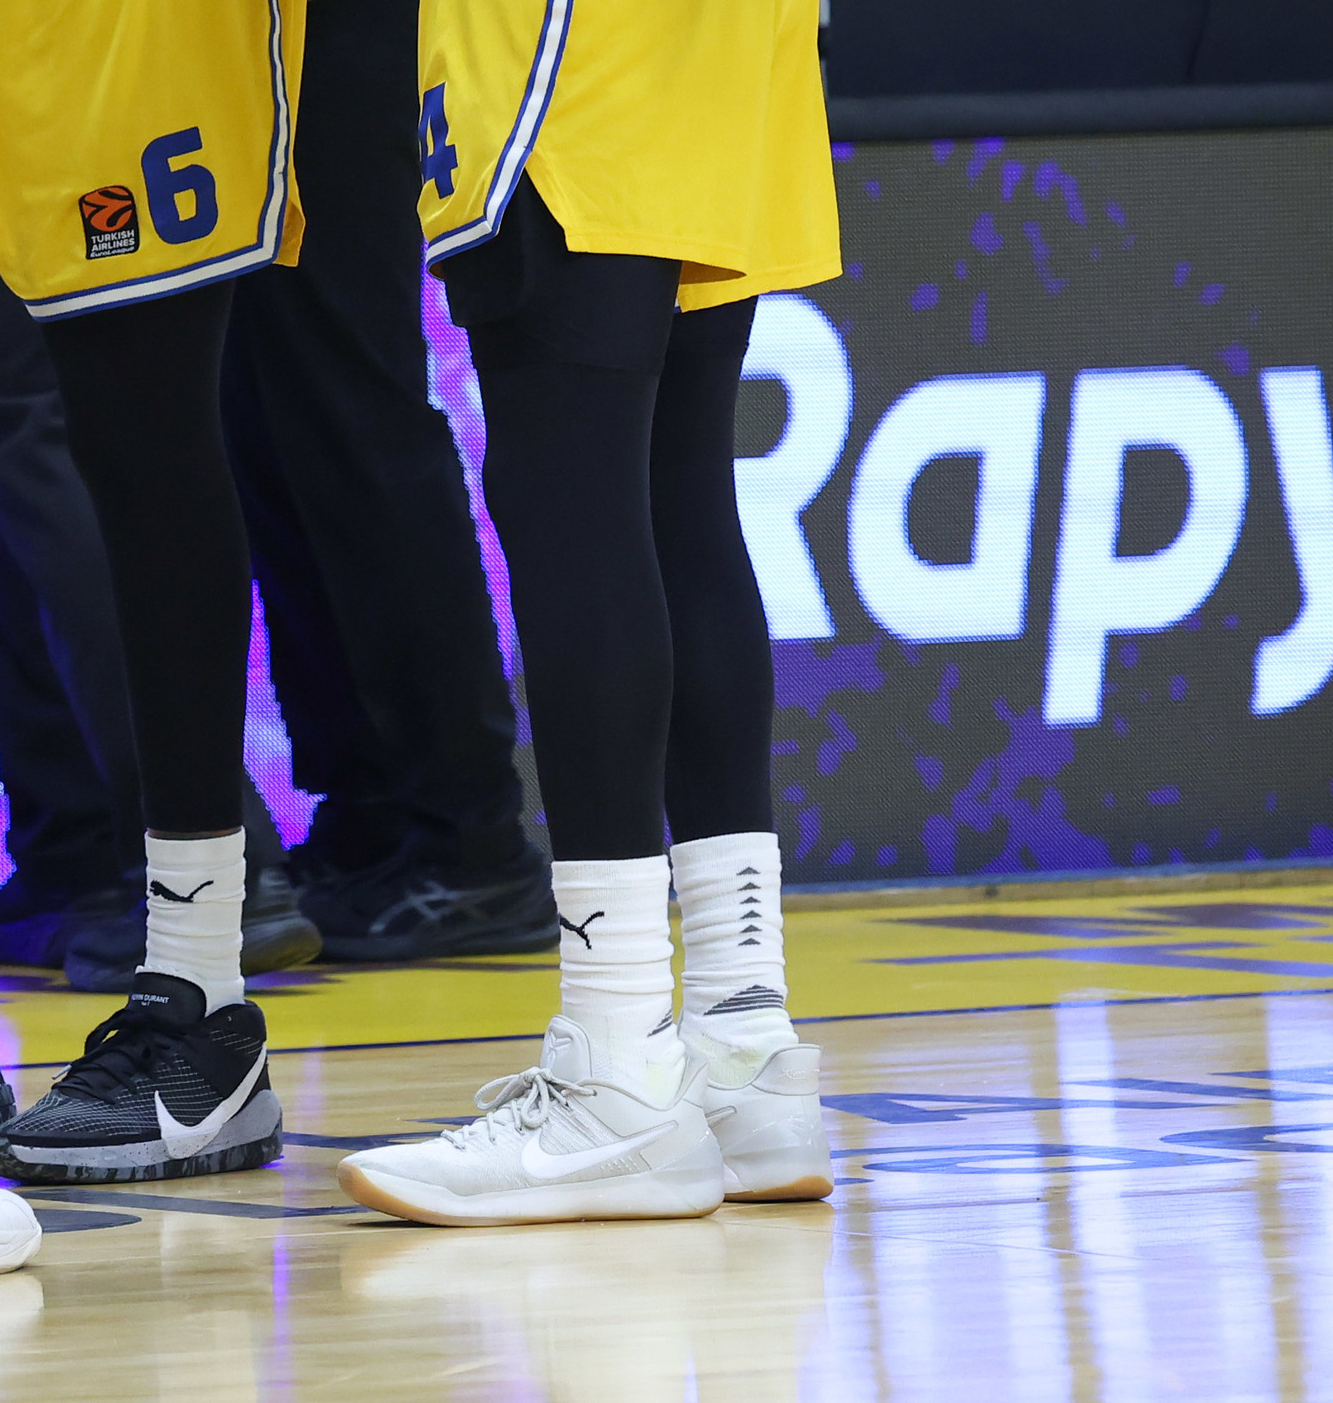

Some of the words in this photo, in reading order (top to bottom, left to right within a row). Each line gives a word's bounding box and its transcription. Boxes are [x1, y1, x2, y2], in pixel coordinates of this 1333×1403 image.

[418, 82, 458, 200] 4
[140, 126, 219, 246] 6
[91, 229, 134, 244] TURKISH
[91, 238, 135, 251] AIRLINES
[90, 247, 134, 257] EuroLeague
[144, 994, 170, 1004] DURANT
